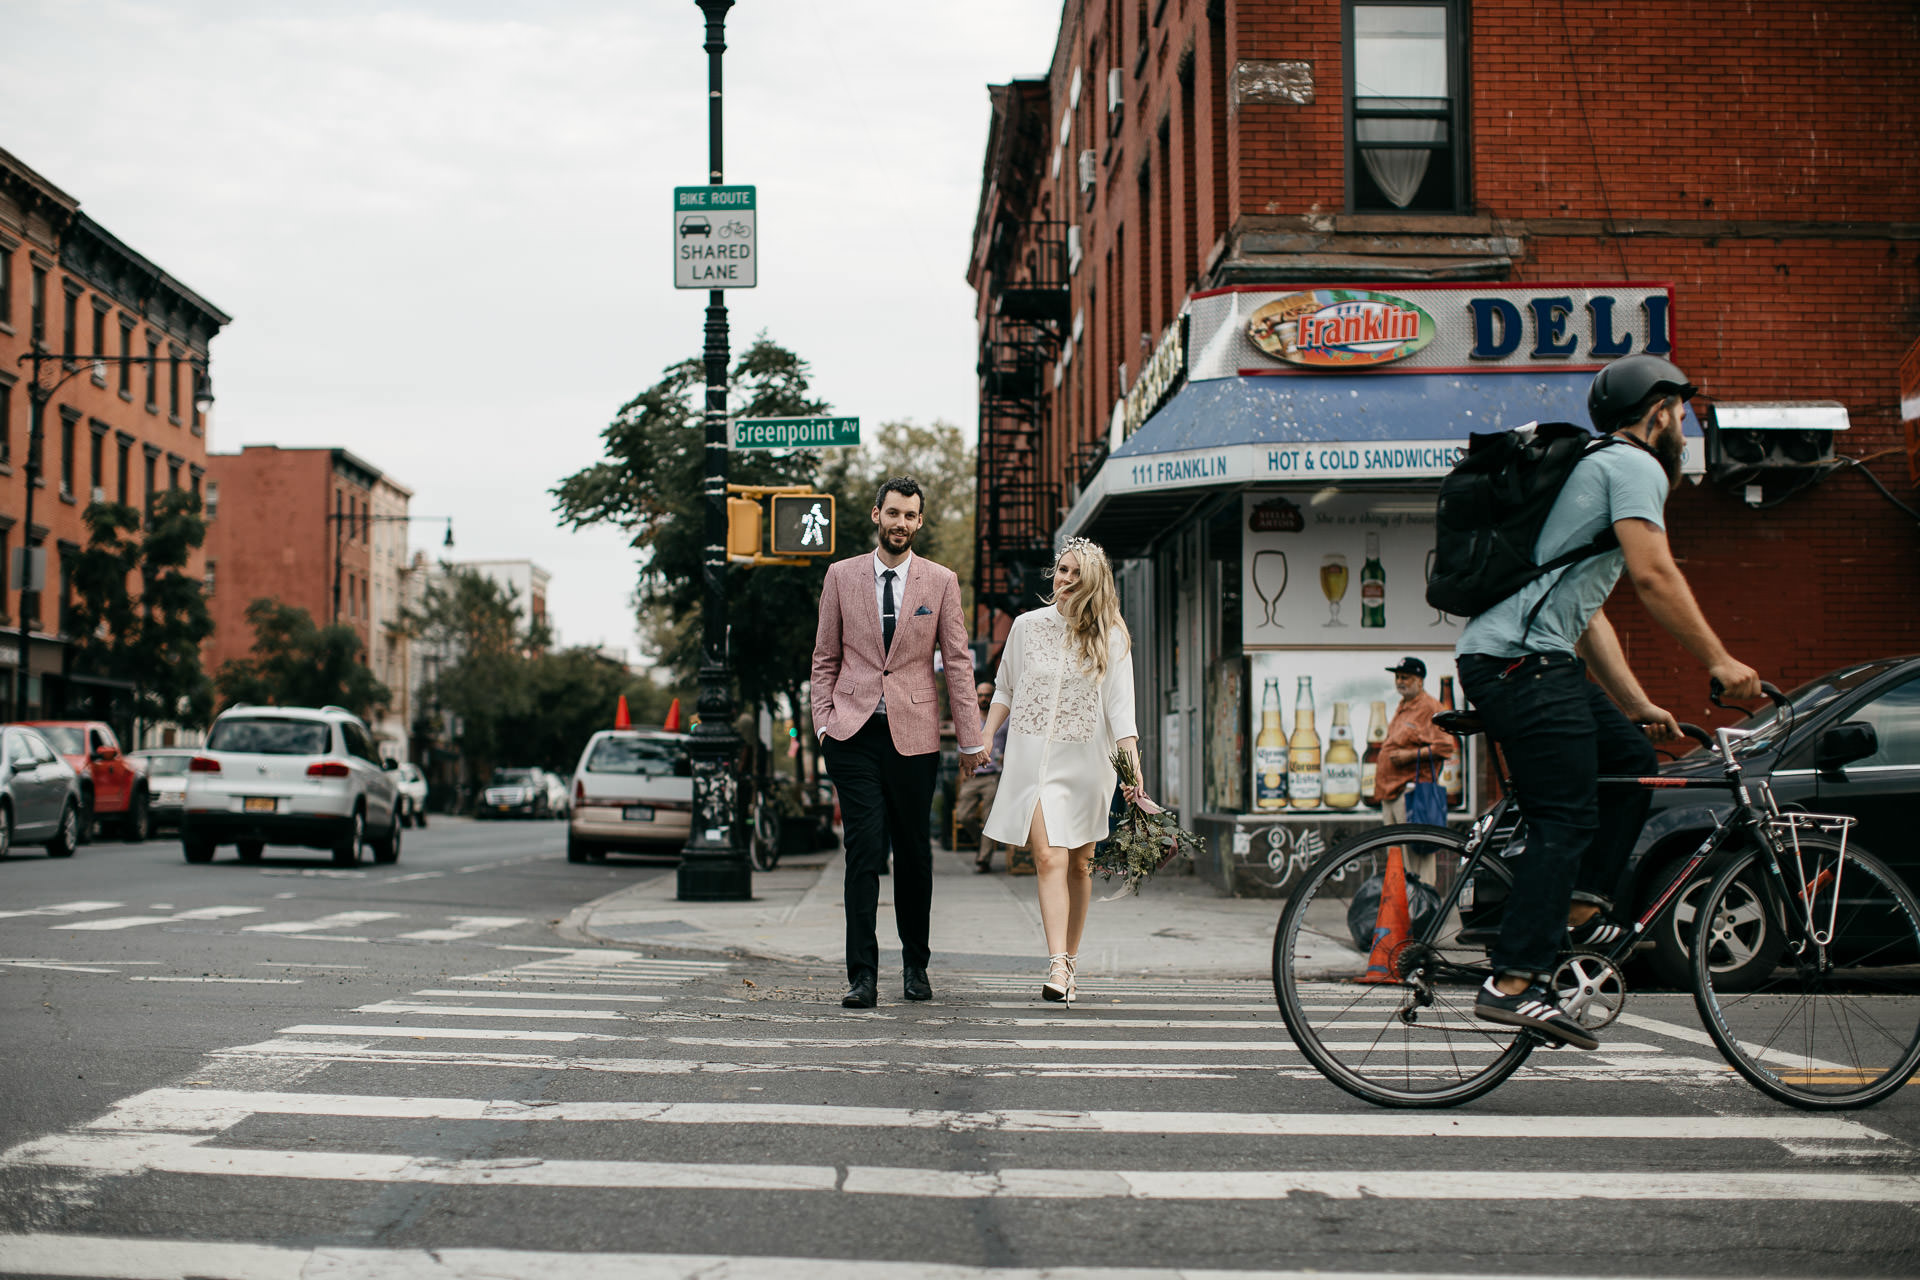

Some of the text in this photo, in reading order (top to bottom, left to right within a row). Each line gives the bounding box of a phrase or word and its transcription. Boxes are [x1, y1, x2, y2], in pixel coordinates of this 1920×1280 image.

[680, 191, 750, 205] BIKE ROUTE
[680, 244, 750, 260] SHARED
[692, 264, 738, 280] LANE
[1297, 306, 1420, 349] Franklin
[1466, 296, 1672, 359] DELI
[735, 420, 857, 447] Greenpoint Av
[1131, 456, 1227, 485] 111 FRANKLIN
[1268, 451, 1300, 471] HOT
[1304, 451, 1315, 470] &
[1320, 450, 1360, 470] COLD
